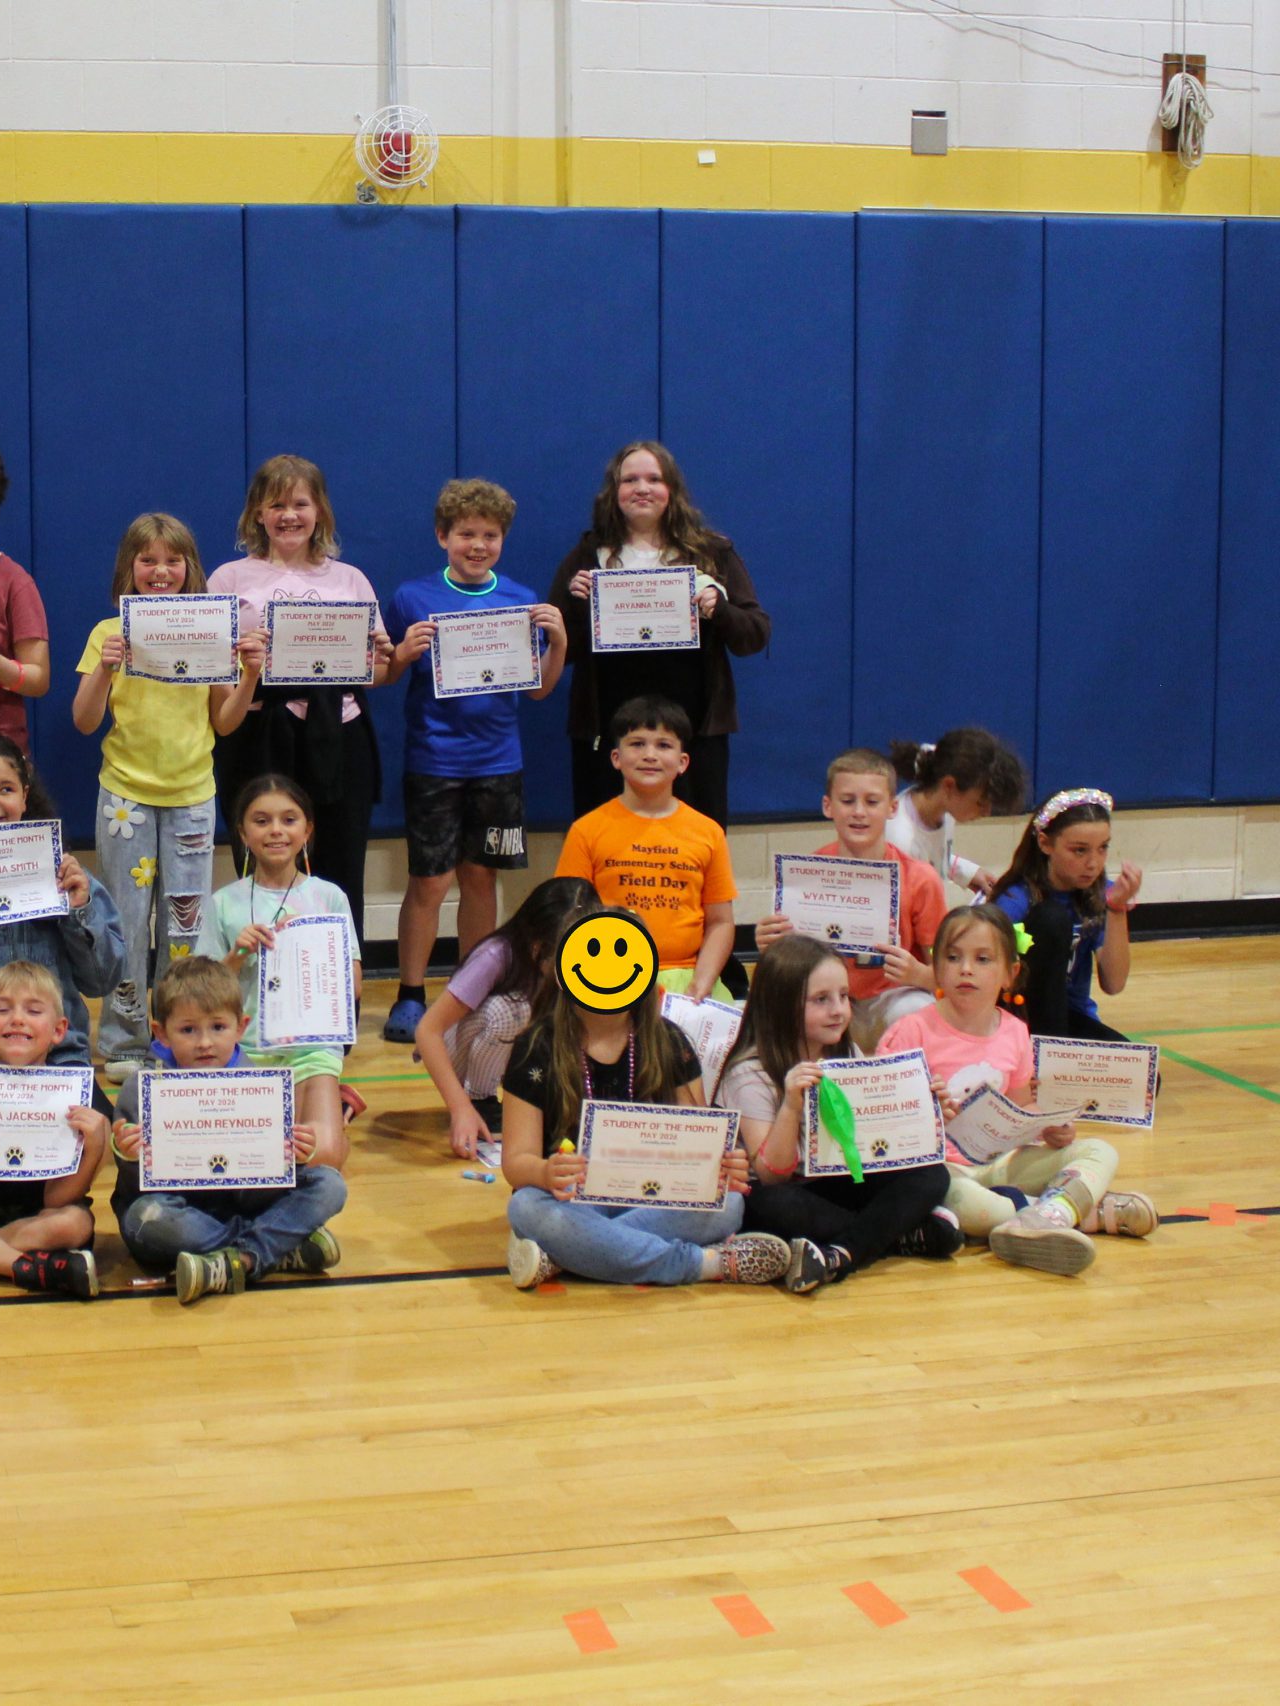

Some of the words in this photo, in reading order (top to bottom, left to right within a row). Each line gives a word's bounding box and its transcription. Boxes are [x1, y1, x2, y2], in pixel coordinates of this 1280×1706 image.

[188, 632, 218, 640] MUNISE
[462, 645, 484, 653] NOAH
[1, 838, 16, 846] THE
[17, 834, 44, 844] MONTH
[500, 826, 524, 855] NBA
[632, 844, 679, 855] Mayfield
[11, 862, 39, 872] SMITH
[604, 859, 666, 870] Elementary
[619, 874, 656, 887] Field
[660, 877, 688, 890] Day
[803, 892, 837, 902] WYATT
[832, 1076, 868, 1086] TUDENT
[871, 1075, 882, 1084] OF
[884, 1073, 898, 1081] THE
[900, 1068, 922, 1080] MONTH
[1054, 1074, 1090, 1082] WILLOW
[1093, 1076, 1133, 1084] HARDING
[21, 1083, 38, 1091] THE
[40, 1084, 72, 1092] MONTH
[160, 1089, 205, 1097] STUDENT
[207, 1088, 218, 1096] OF
[221, 1088, 239, 1096] THE
[242, 1087, 274, 1095] MONTH
[901, 1100, 920, 1110] HINE
[6, 1111, 56, 1121] JACKSON
[163, 1120, 212, 1130] WAYLON
[214, 1118, 272, 1128] REYNOLDS
[603, 1119, 647, 1129] STUDENT
[650, 1122, 661, 1130] OF
[664, 1123, 681, 1132] THE
[685, 1124, 718, 1133] MONTH
